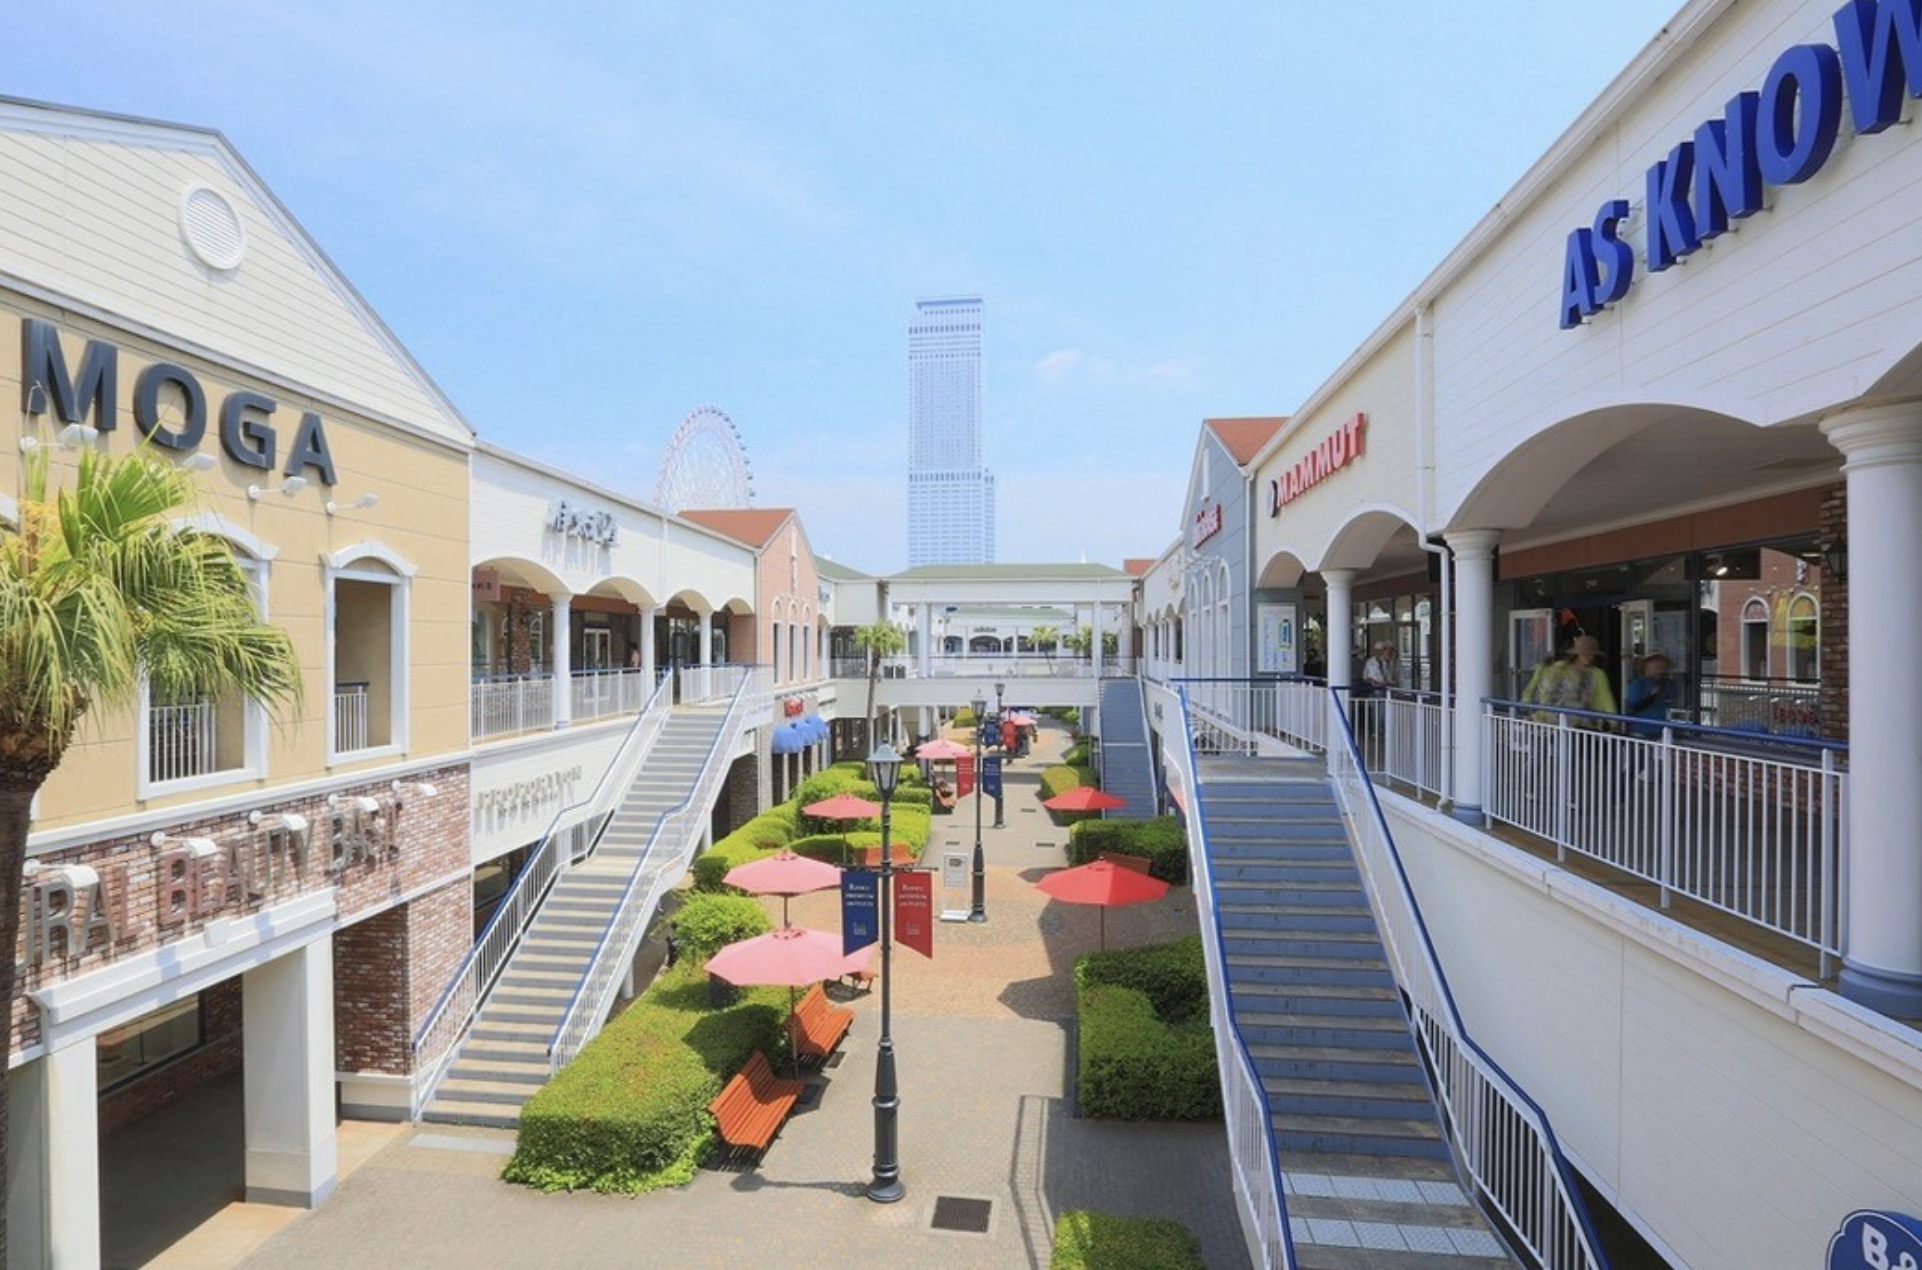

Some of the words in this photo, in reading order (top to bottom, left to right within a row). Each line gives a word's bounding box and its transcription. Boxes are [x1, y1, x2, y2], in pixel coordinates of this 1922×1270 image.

[1559, 199, 1634, 330] AS
[1646, 0, 1922, 272] KNOW
[21, 317, 338, 486] MOGA
[1277, 412, 1367, 508] MAMMUT
[161, 819, 315, 921] BEAUTY
